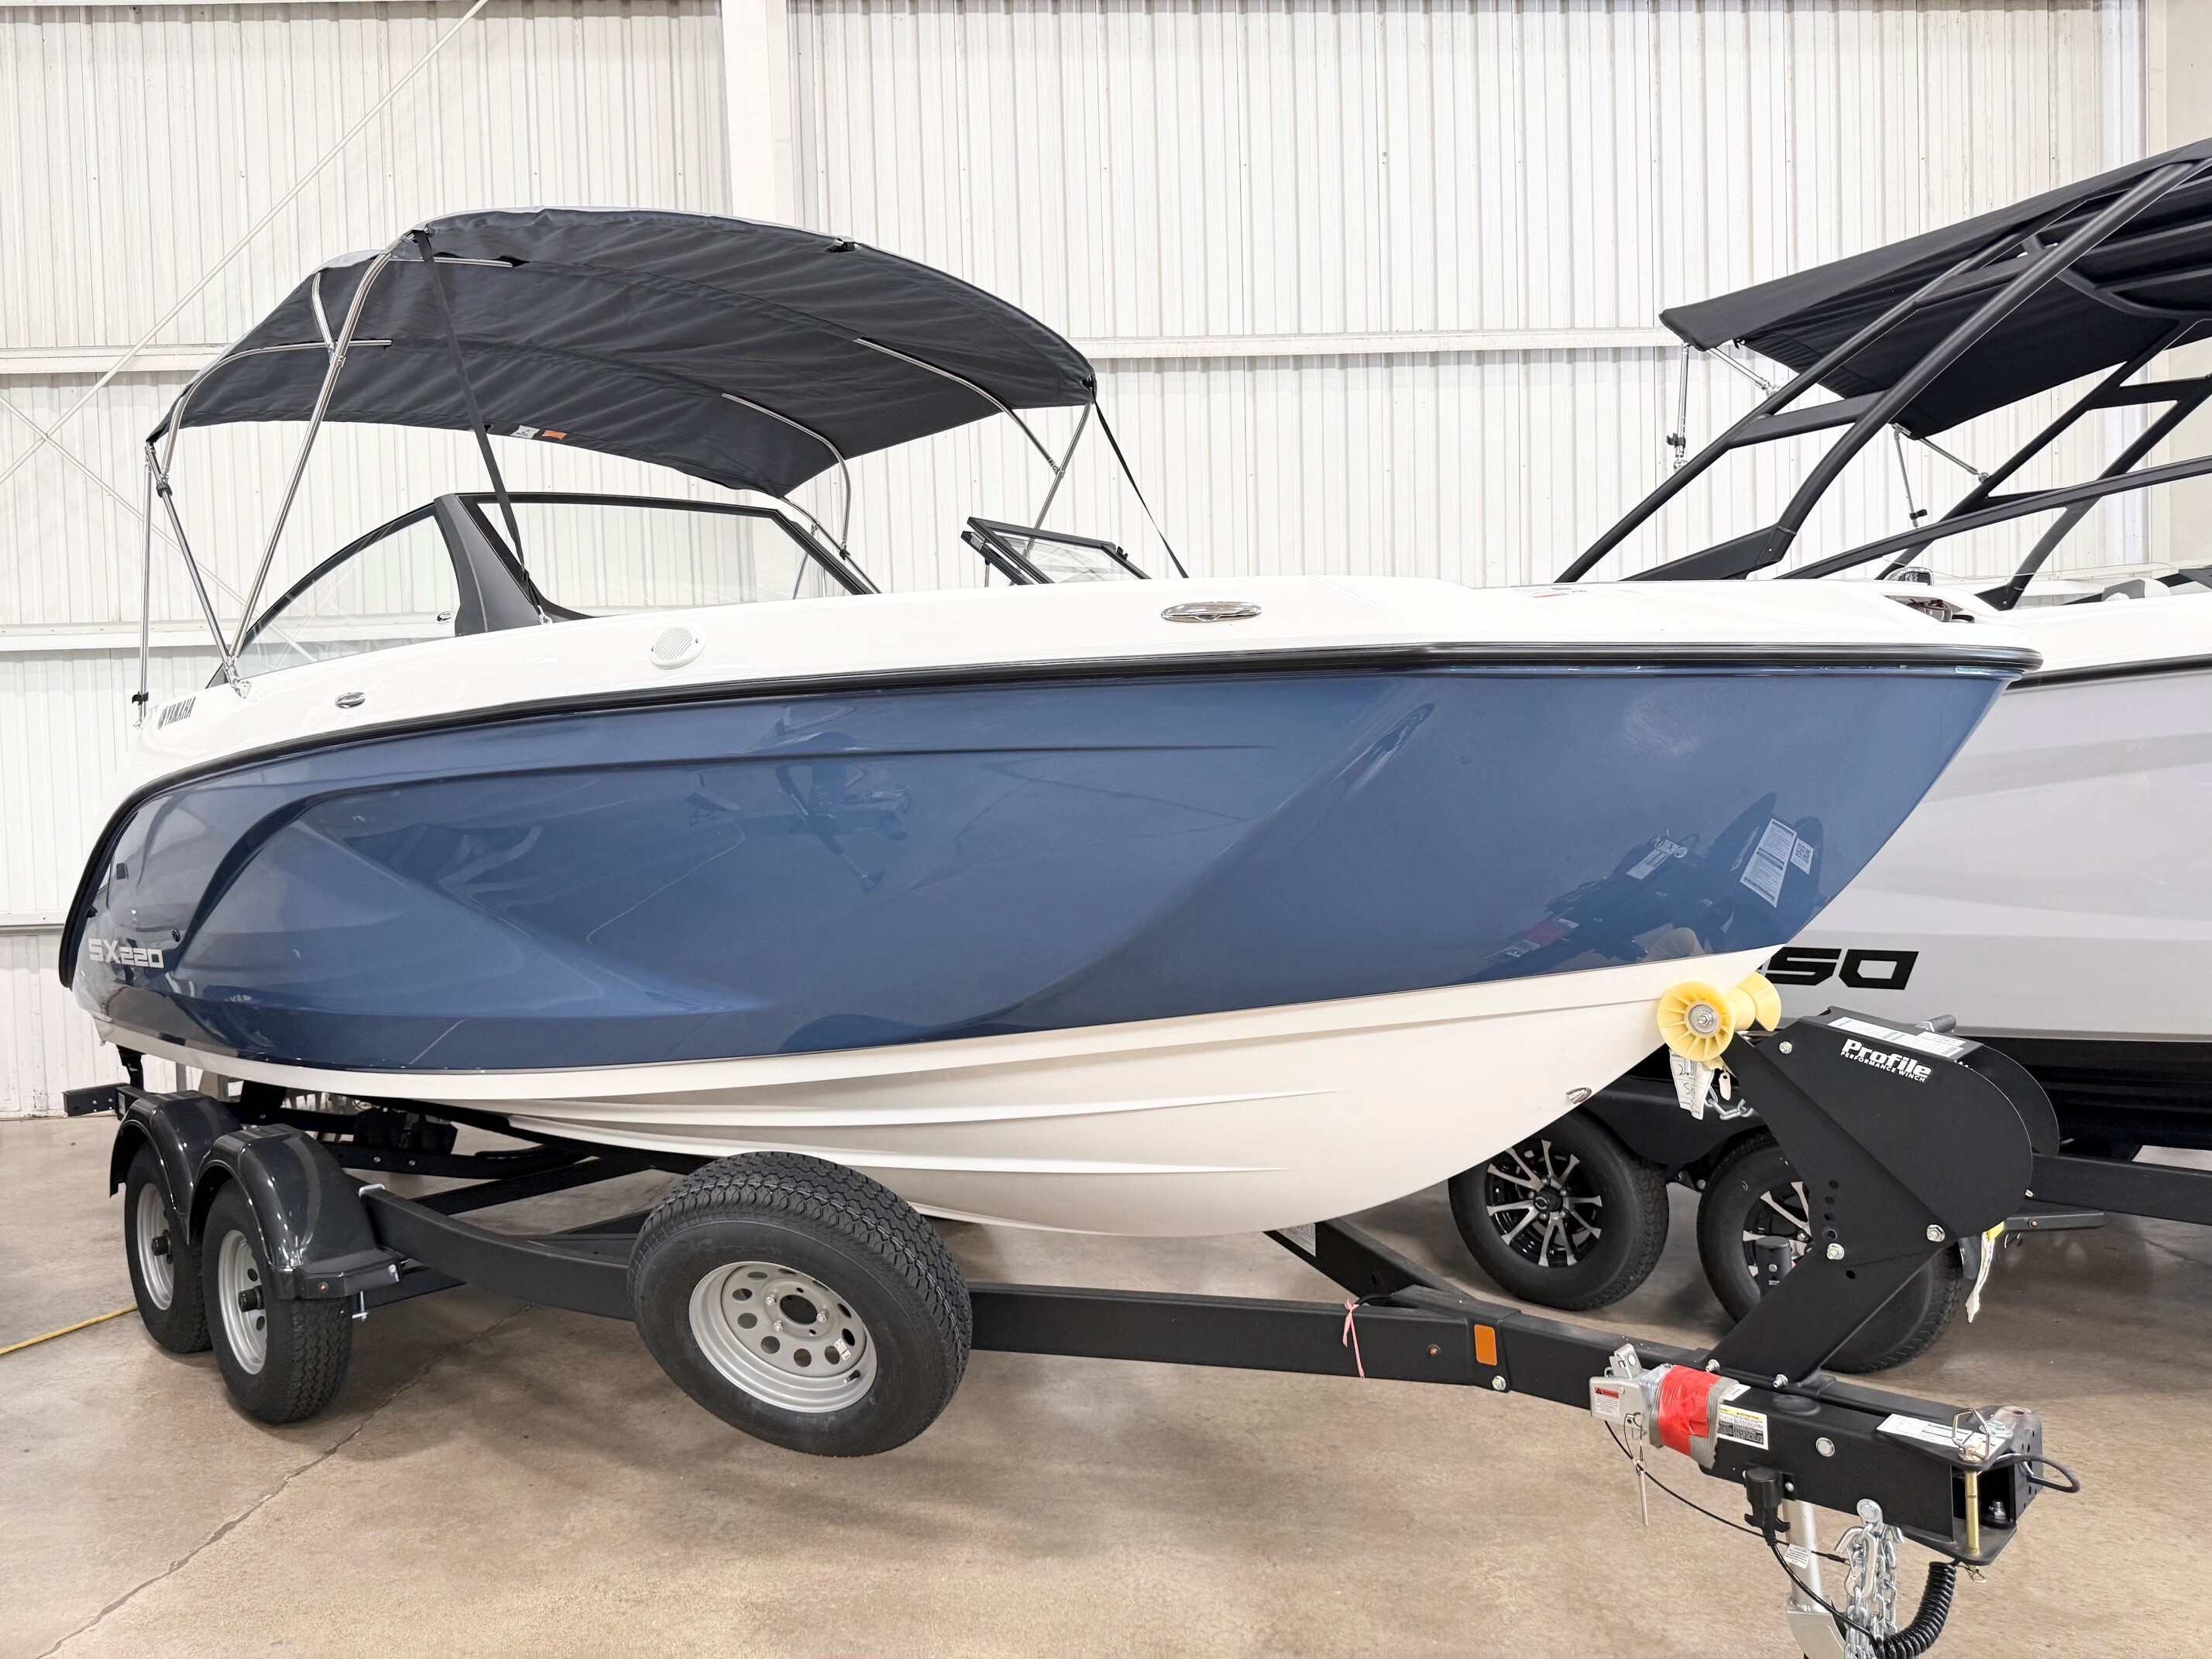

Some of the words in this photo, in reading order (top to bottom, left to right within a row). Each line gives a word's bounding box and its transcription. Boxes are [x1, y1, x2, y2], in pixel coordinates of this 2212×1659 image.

[164, 697, 196, 726] YAMAHA
[88, 938, 164, 969] SX220
[1840, 1051, 1897, 1073] PERFORMANCE
[1898, 1070, 1926, 1083] WINCH
[1841, 1038, 1932, 1079] Profile
